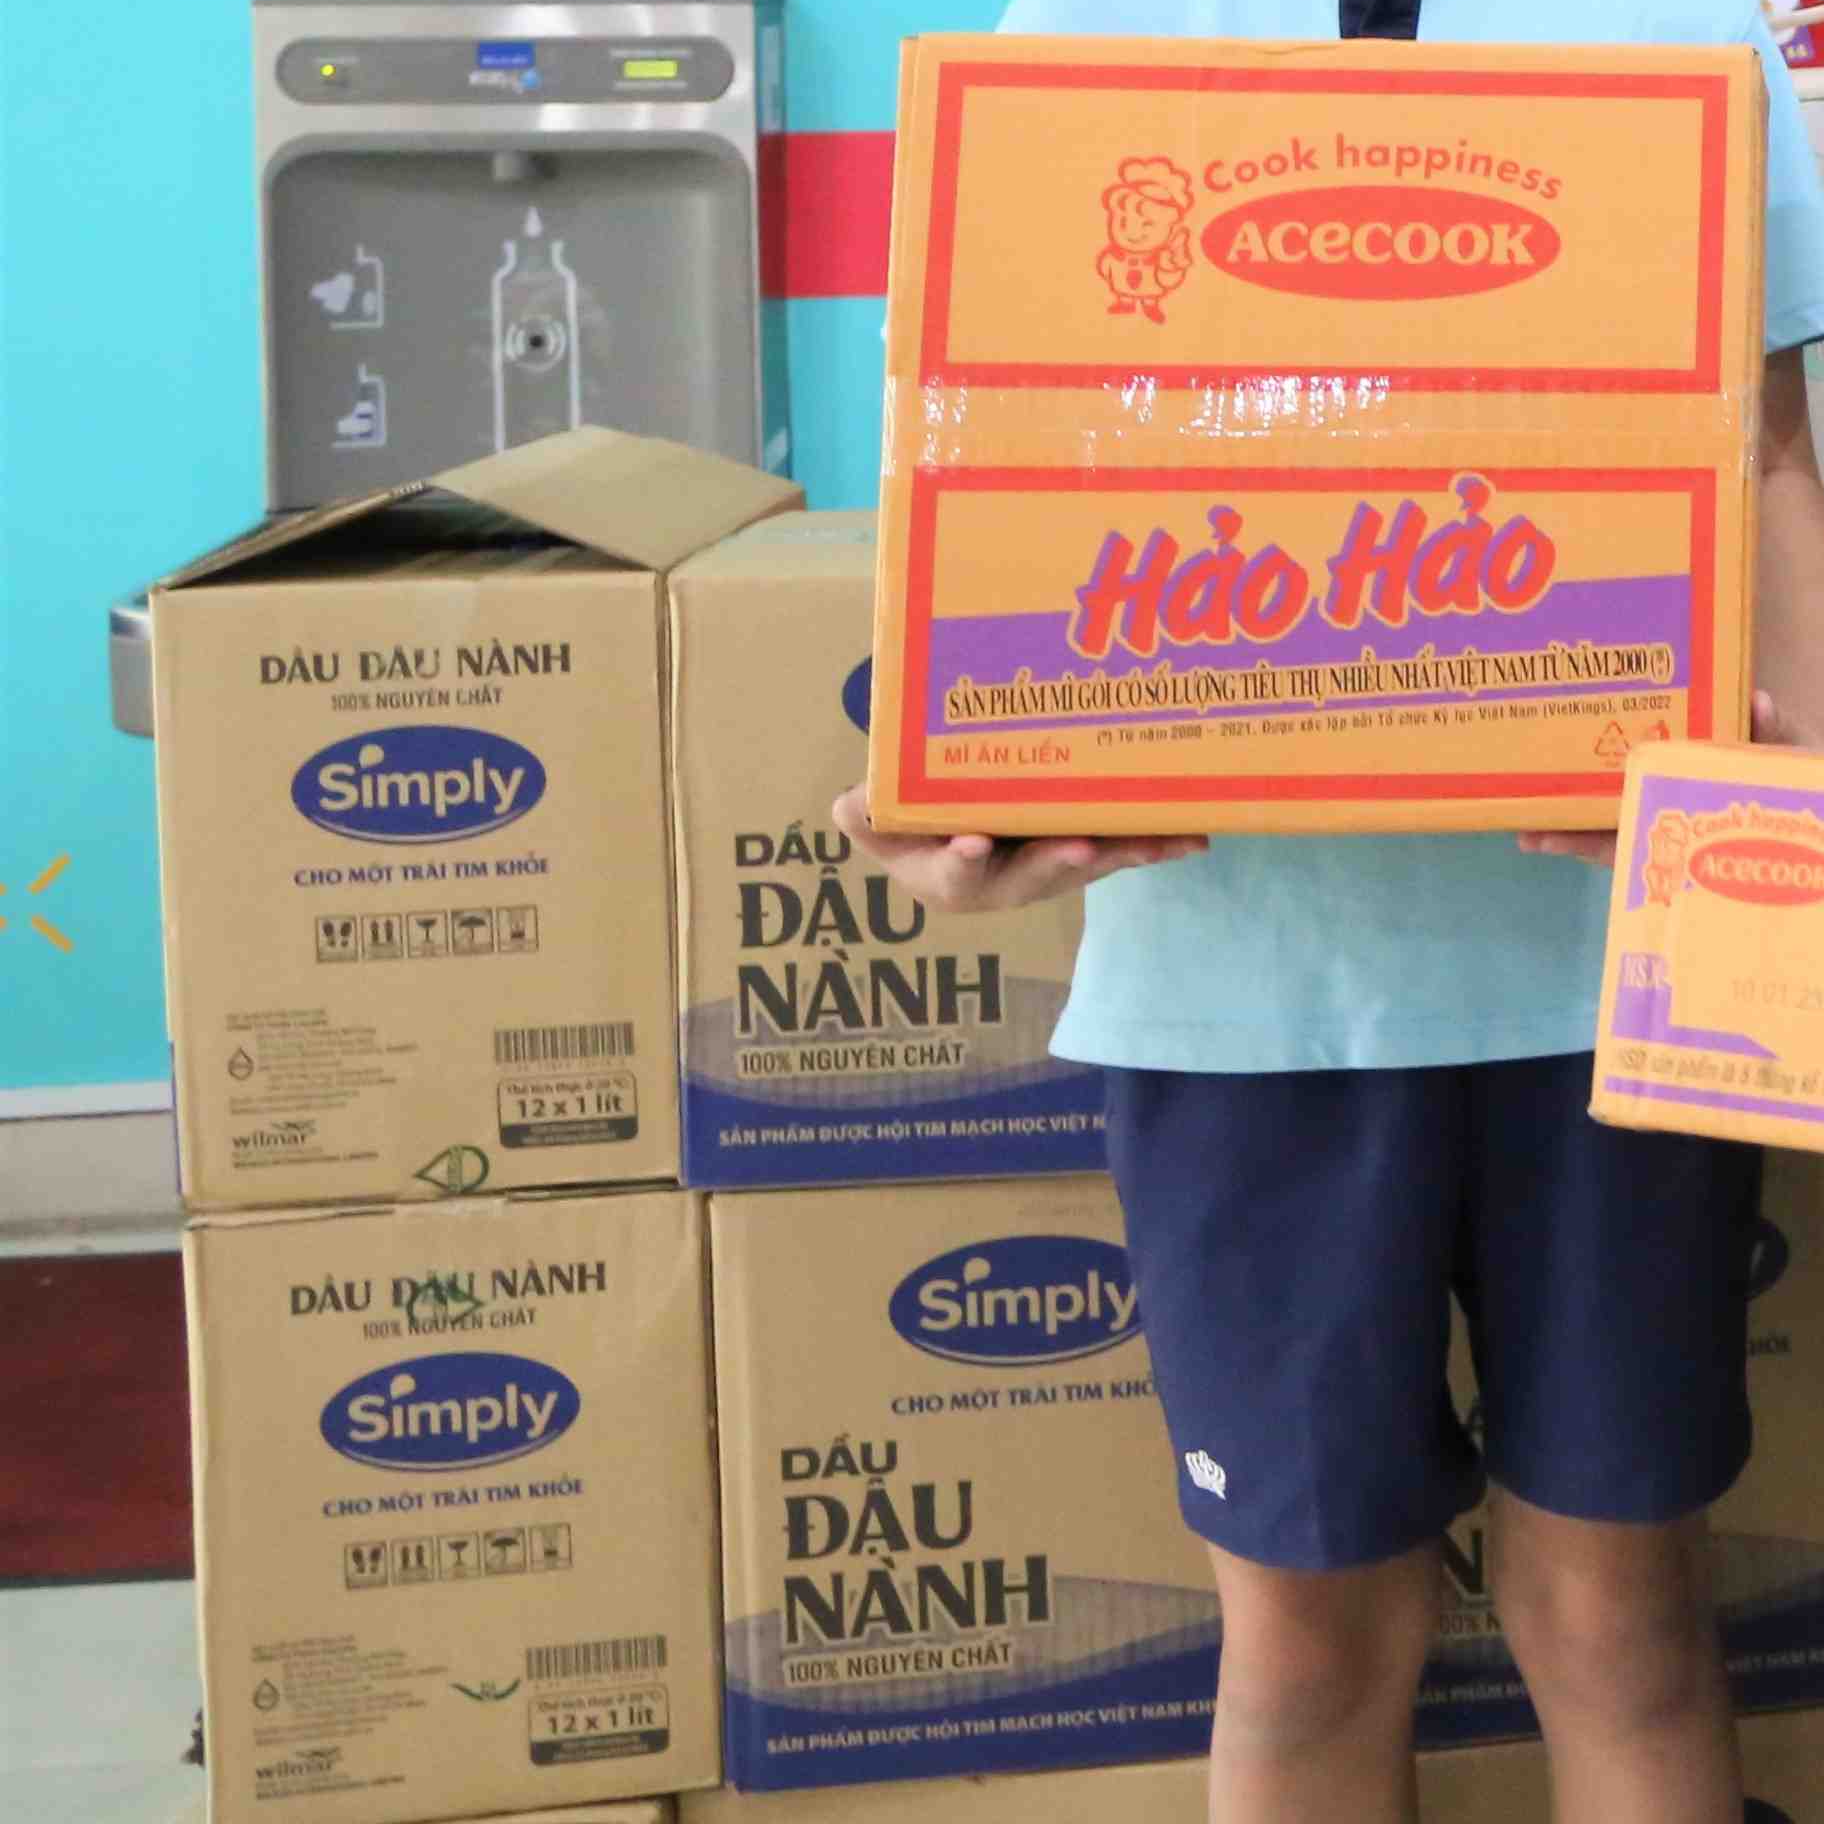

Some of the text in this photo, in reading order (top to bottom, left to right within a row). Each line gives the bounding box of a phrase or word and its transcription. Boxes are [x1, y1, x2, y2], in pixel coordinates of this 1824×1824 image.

[1203, 135, 1563, 201] Cook happiness
[1069, 473, 1557, 658] Hảo Hảo
[319, 744, 525, 818] Simply
[735, 819, 851, 868] DẦU
[736, 866, 926, 949] ĐẬU
[736, 945, 1001, 1034] NÀNH
[741, 1040, 966, 1075] 100% NGUYÊN CHẤT
[515, 1090, 624, 1119] 12 x 1 lít
[917, 1256, 1137, 1335] Simply
[347, 1373, 558, 1444] Simply
[781, 1433, 899, 1482] DẦU
[783, 1478, 973, 1562] ĐẬU
[783, 1554, 1050, 1645] NÀNH
